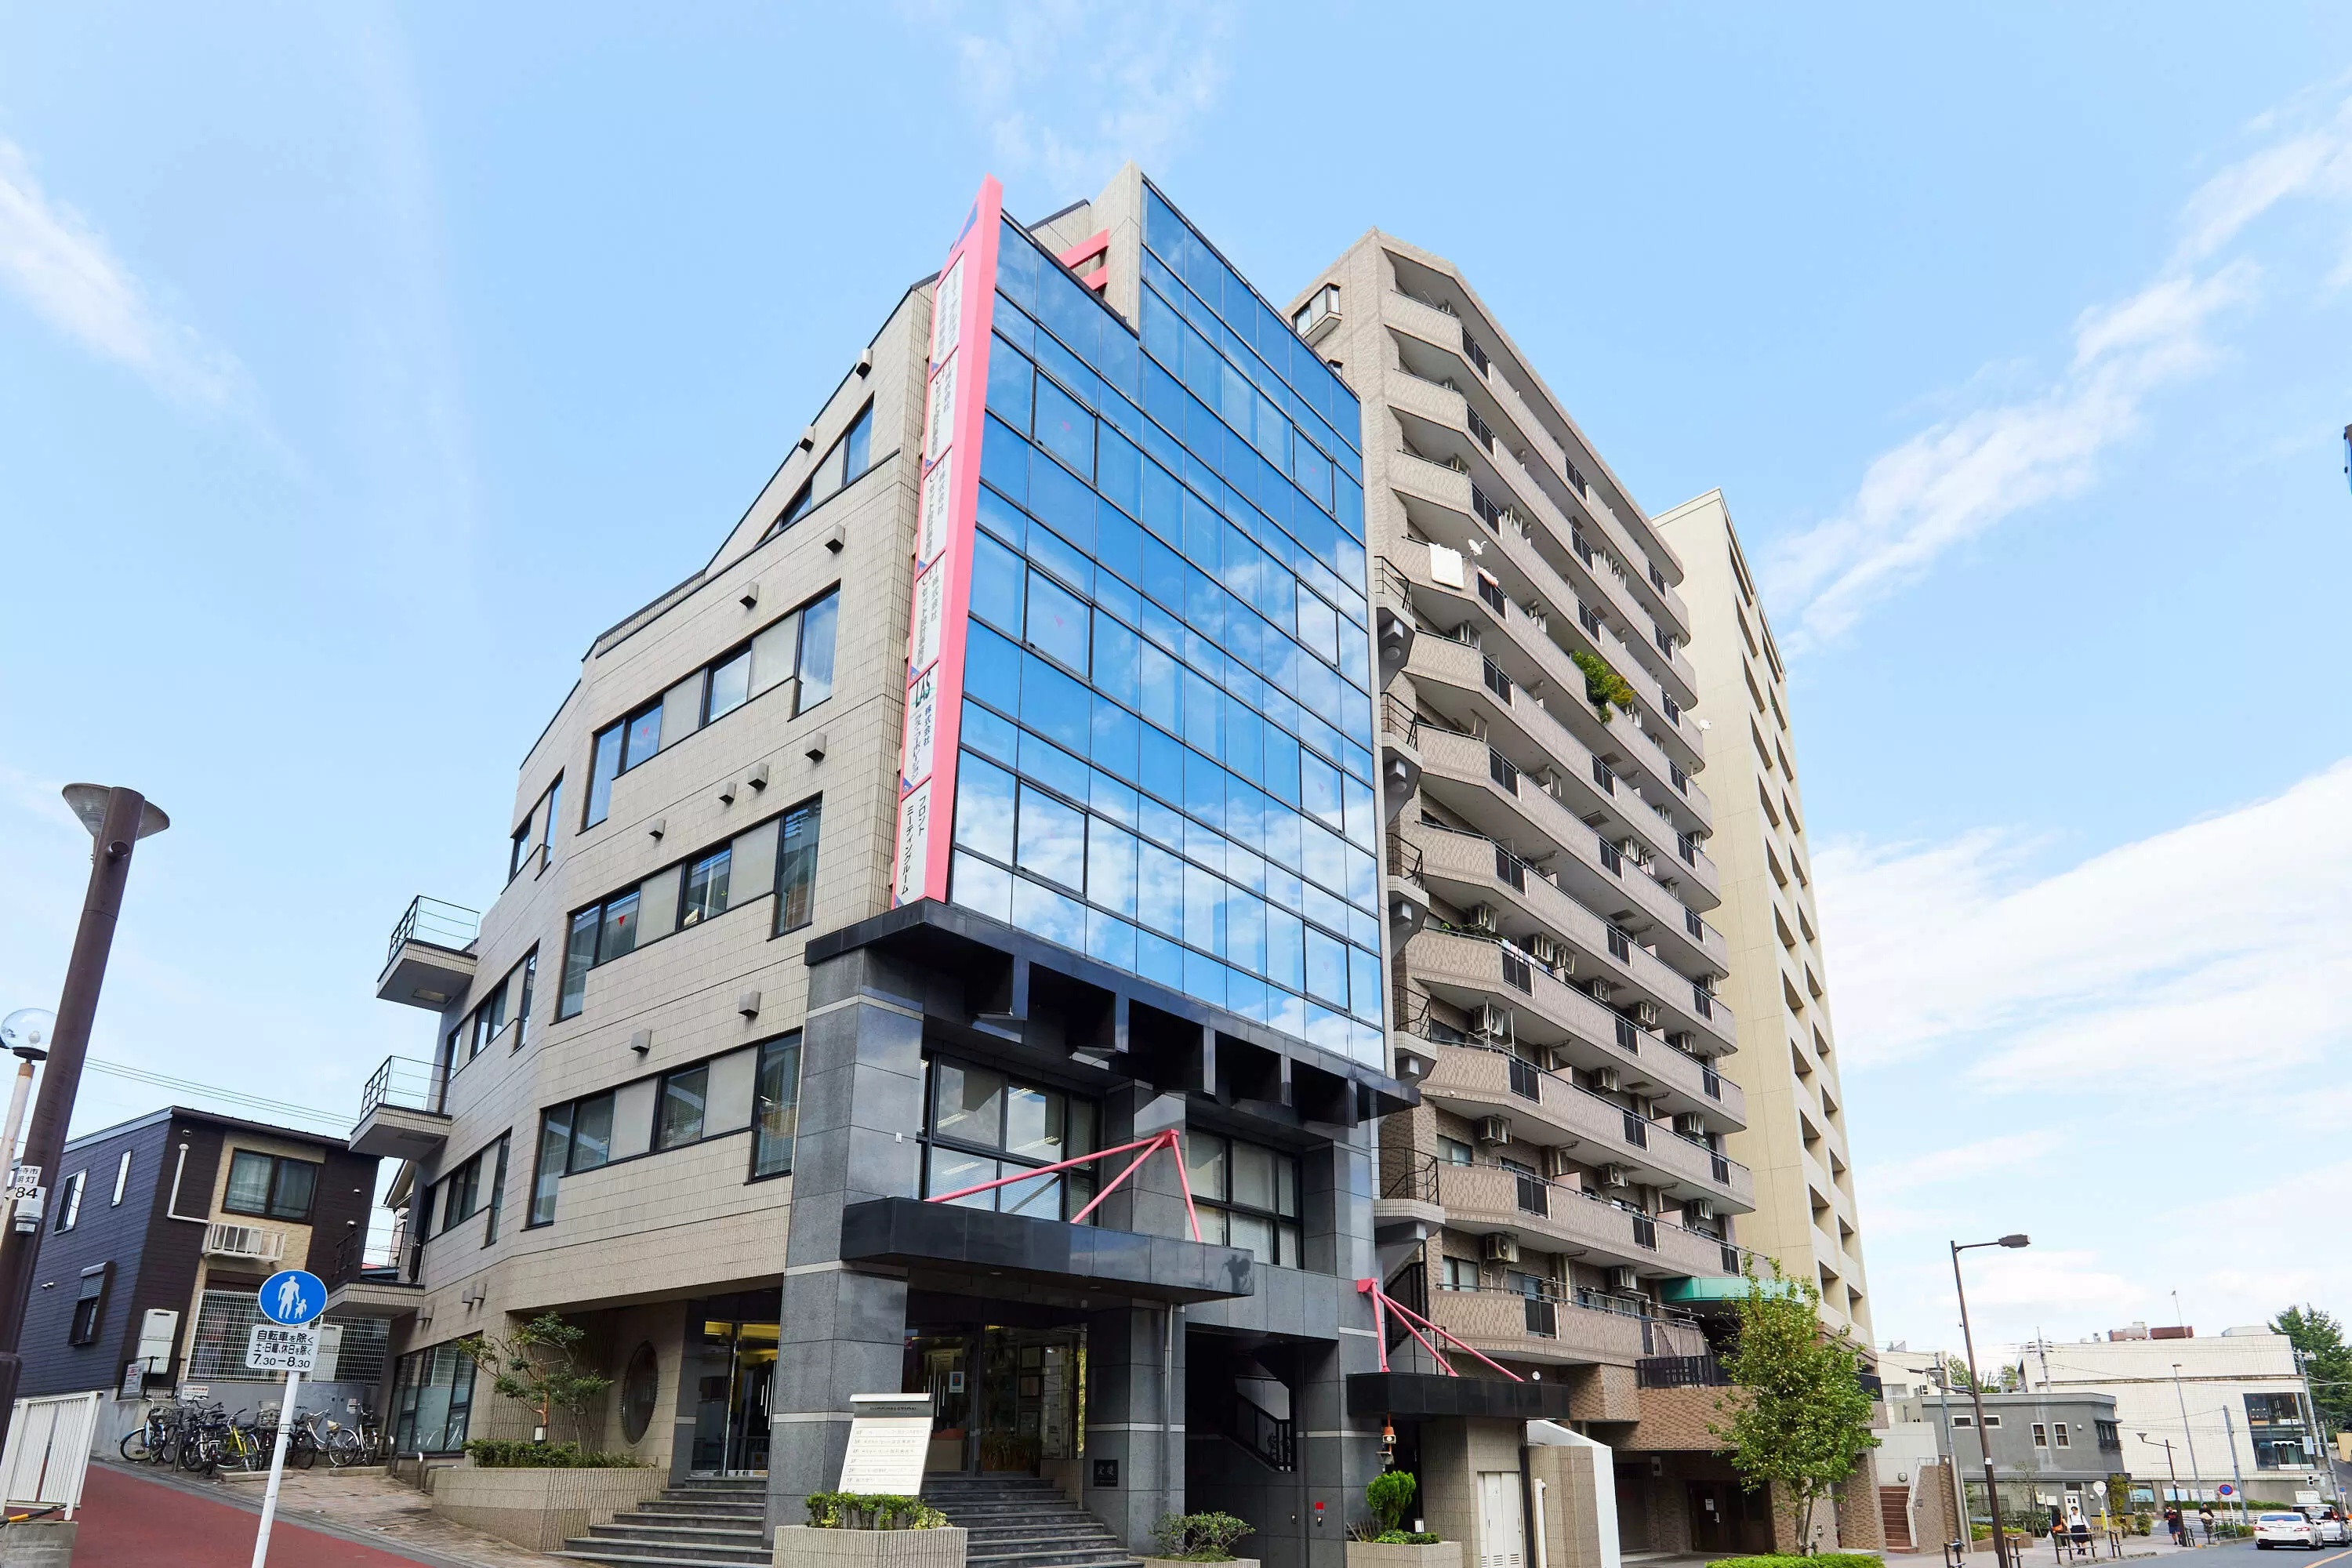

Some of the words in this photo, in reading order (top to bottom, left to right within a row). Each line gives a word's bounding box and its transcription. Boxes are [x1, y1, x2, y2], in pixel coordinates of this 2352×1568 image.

[915, 669, 931, 708] LAS
[924, 704, 932, 746] 株式会社
[918, 795, 927, 837] フロント
[902, 804, 914, 895] ミーティングルーム
[256, 1330, 314, 1344] 自転車を除く
